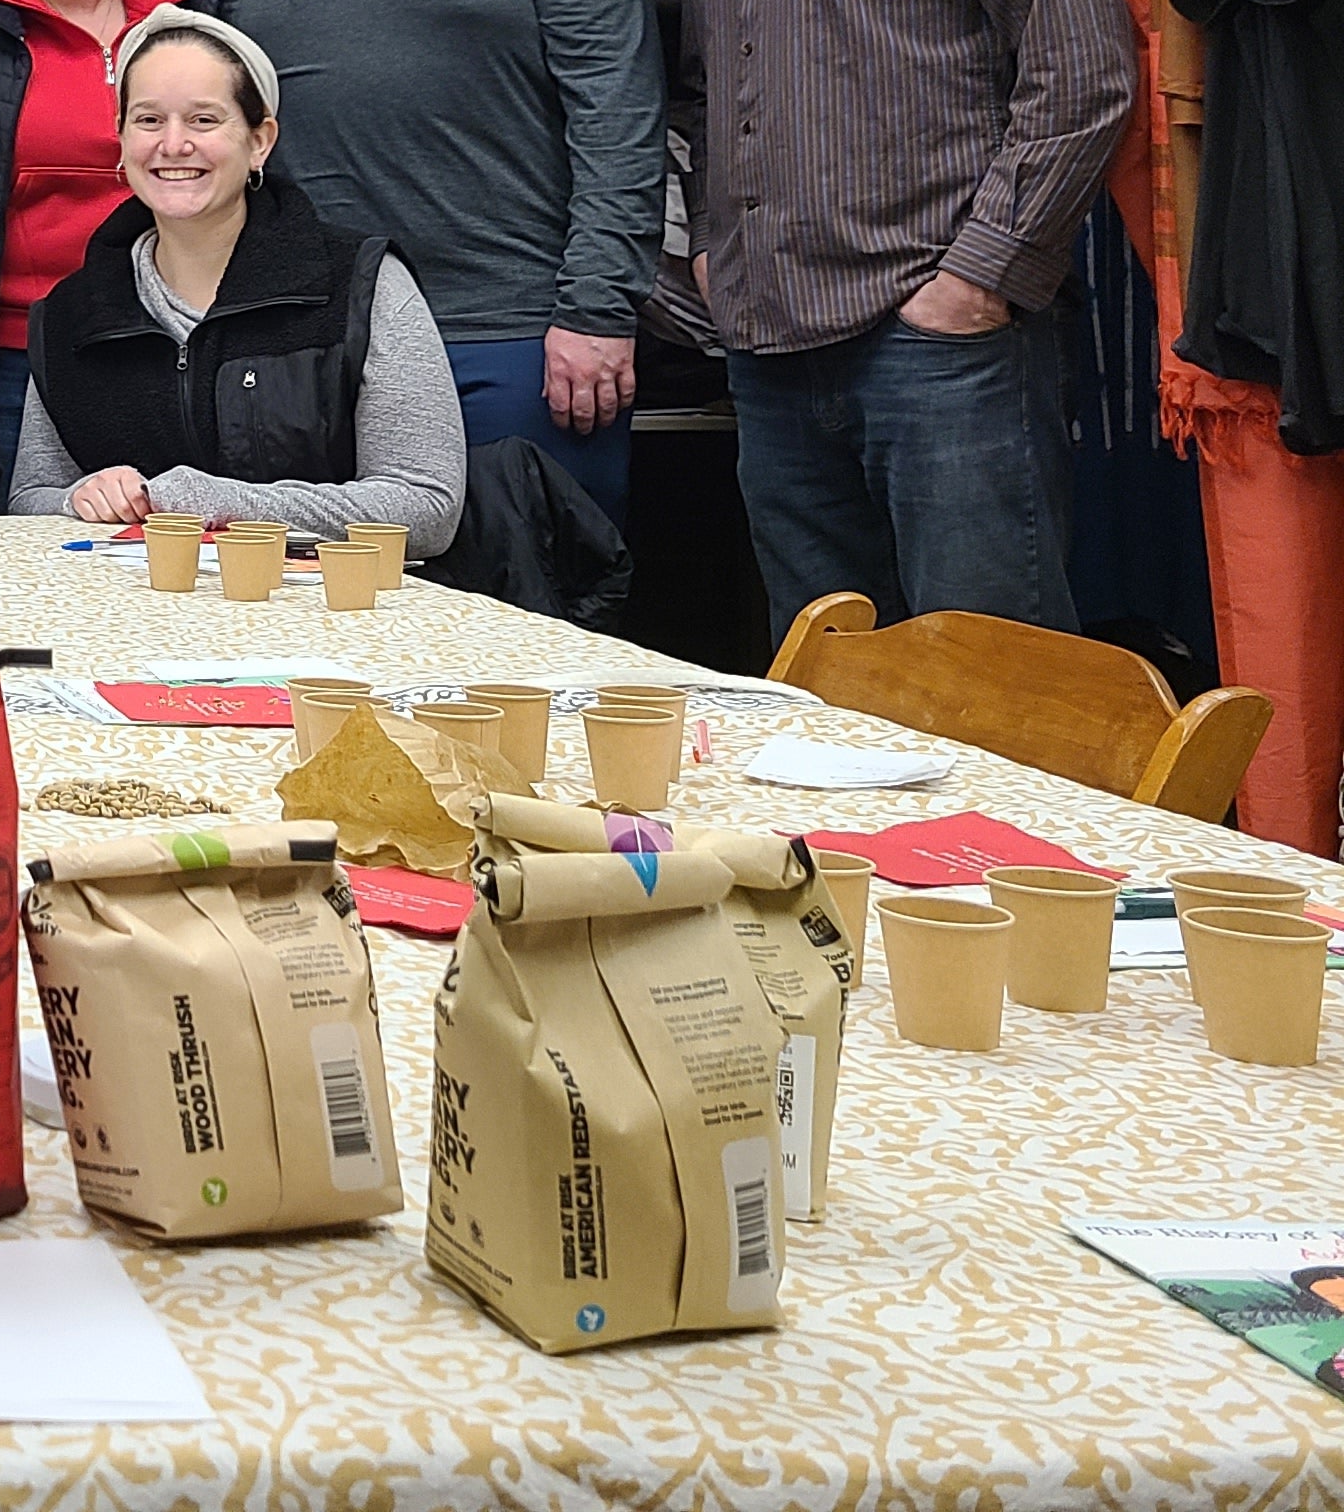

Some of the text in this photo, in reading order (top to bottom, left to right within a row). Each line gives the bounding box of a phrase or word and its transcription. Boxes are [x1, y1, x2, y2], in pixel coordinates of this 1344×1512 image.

[173, 995, 215, 1153] WOOD THRUSH
[544, 1046, 598, 1279] AMERICAN REDSTART
[1085, 1225, 1322, 1243] The History of
